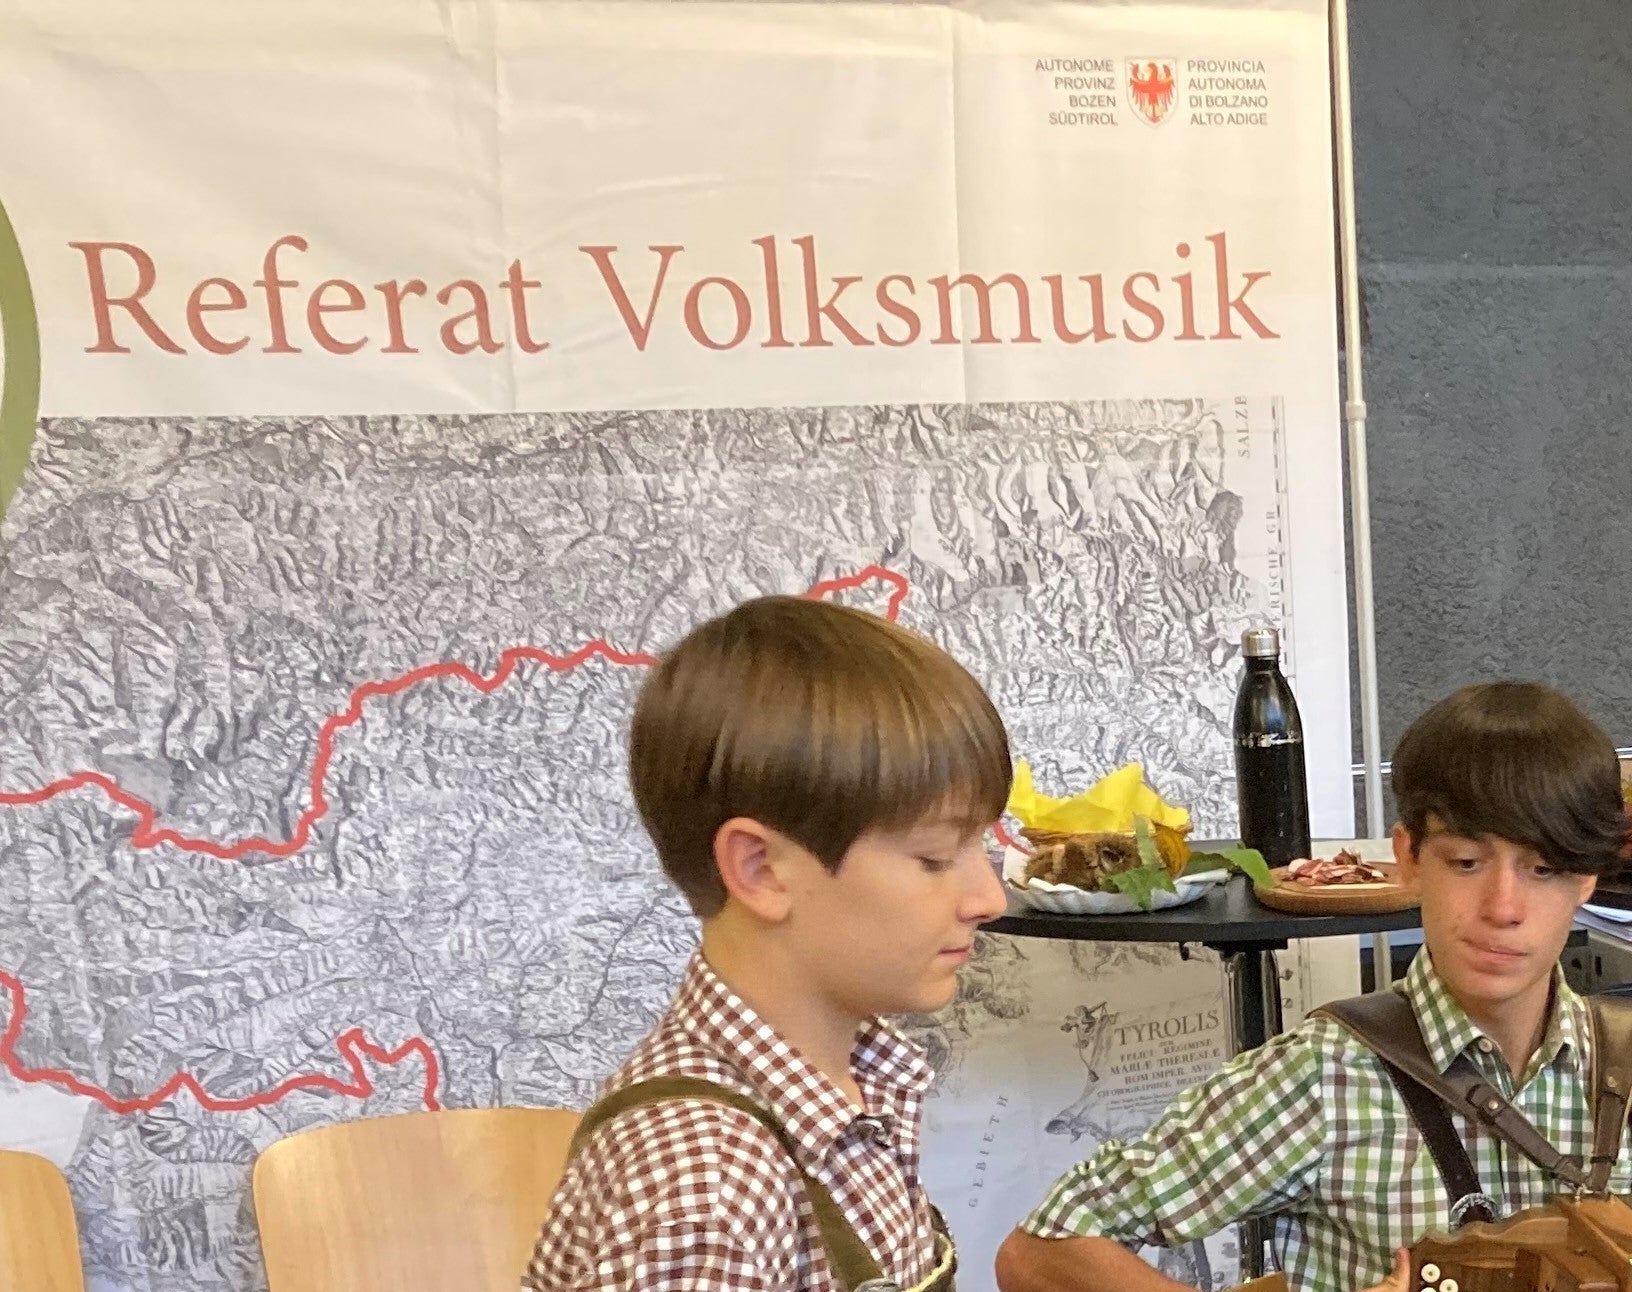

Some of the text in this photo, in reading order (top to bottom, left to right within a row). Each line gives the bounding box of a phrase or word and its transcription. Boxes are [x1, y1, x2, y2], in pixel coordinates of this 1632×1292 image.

[1035, 58, 1114, 73] AUTONOME
[1187, 59, 1265, 73] PROVINCIA
[1054, 76, 1115, 90] PROVINZ
[1188, 77, 1266, 91] AUTONOMA
[1069, 95, 1116, 108] BOZEN
[1189, 95, 1268, 108] DI BOLZANO
[1049, 110, 1118, 126] SÜDTIROL
[1190, 112, 1268, 126] ALTO ADIGE
[67, 231, 1281, 355] Referat Volksmusik
[1113, 1009, 1220, 1046] TYROLIS
[968, 1095, 1009, 1208] GEBIETH
